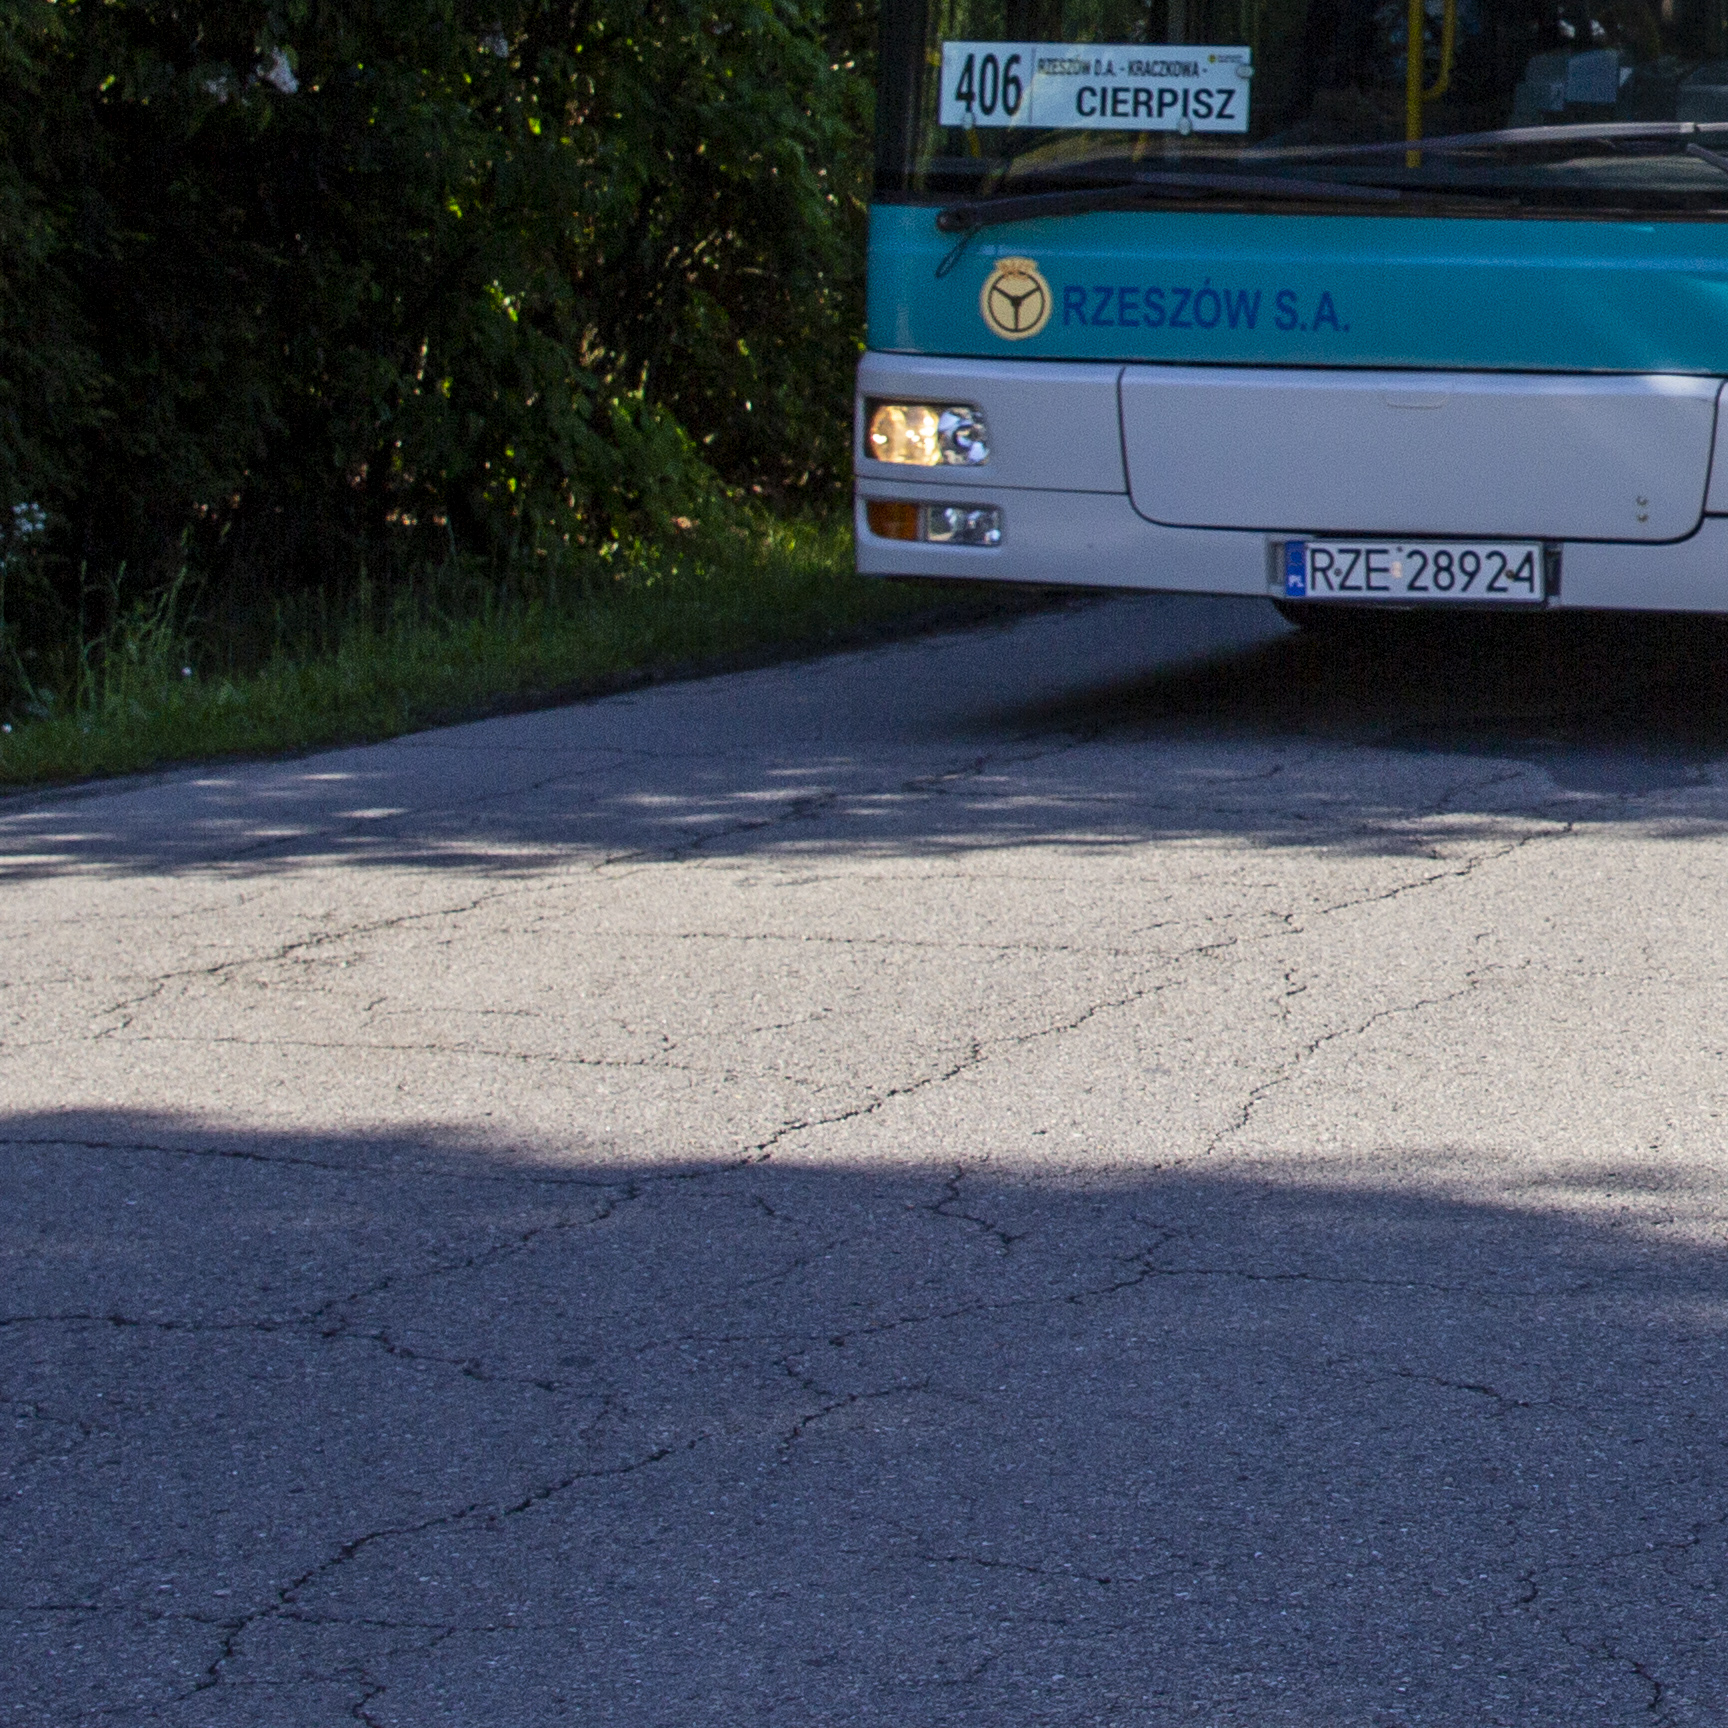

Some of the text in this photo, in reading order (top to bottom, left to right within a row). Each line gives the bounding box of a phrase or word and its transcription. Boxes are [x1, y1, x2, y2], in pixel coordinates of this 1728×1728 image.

[956, 52, 1022, 116] 406
[1076, 85, 1236, 119] CIERPISZ
[1062, 276, 1350, 332] RZESZÓW S.A.
[1310, 547, 1391, 592] RZE
[1406, 549, 1535, 594] 28924
